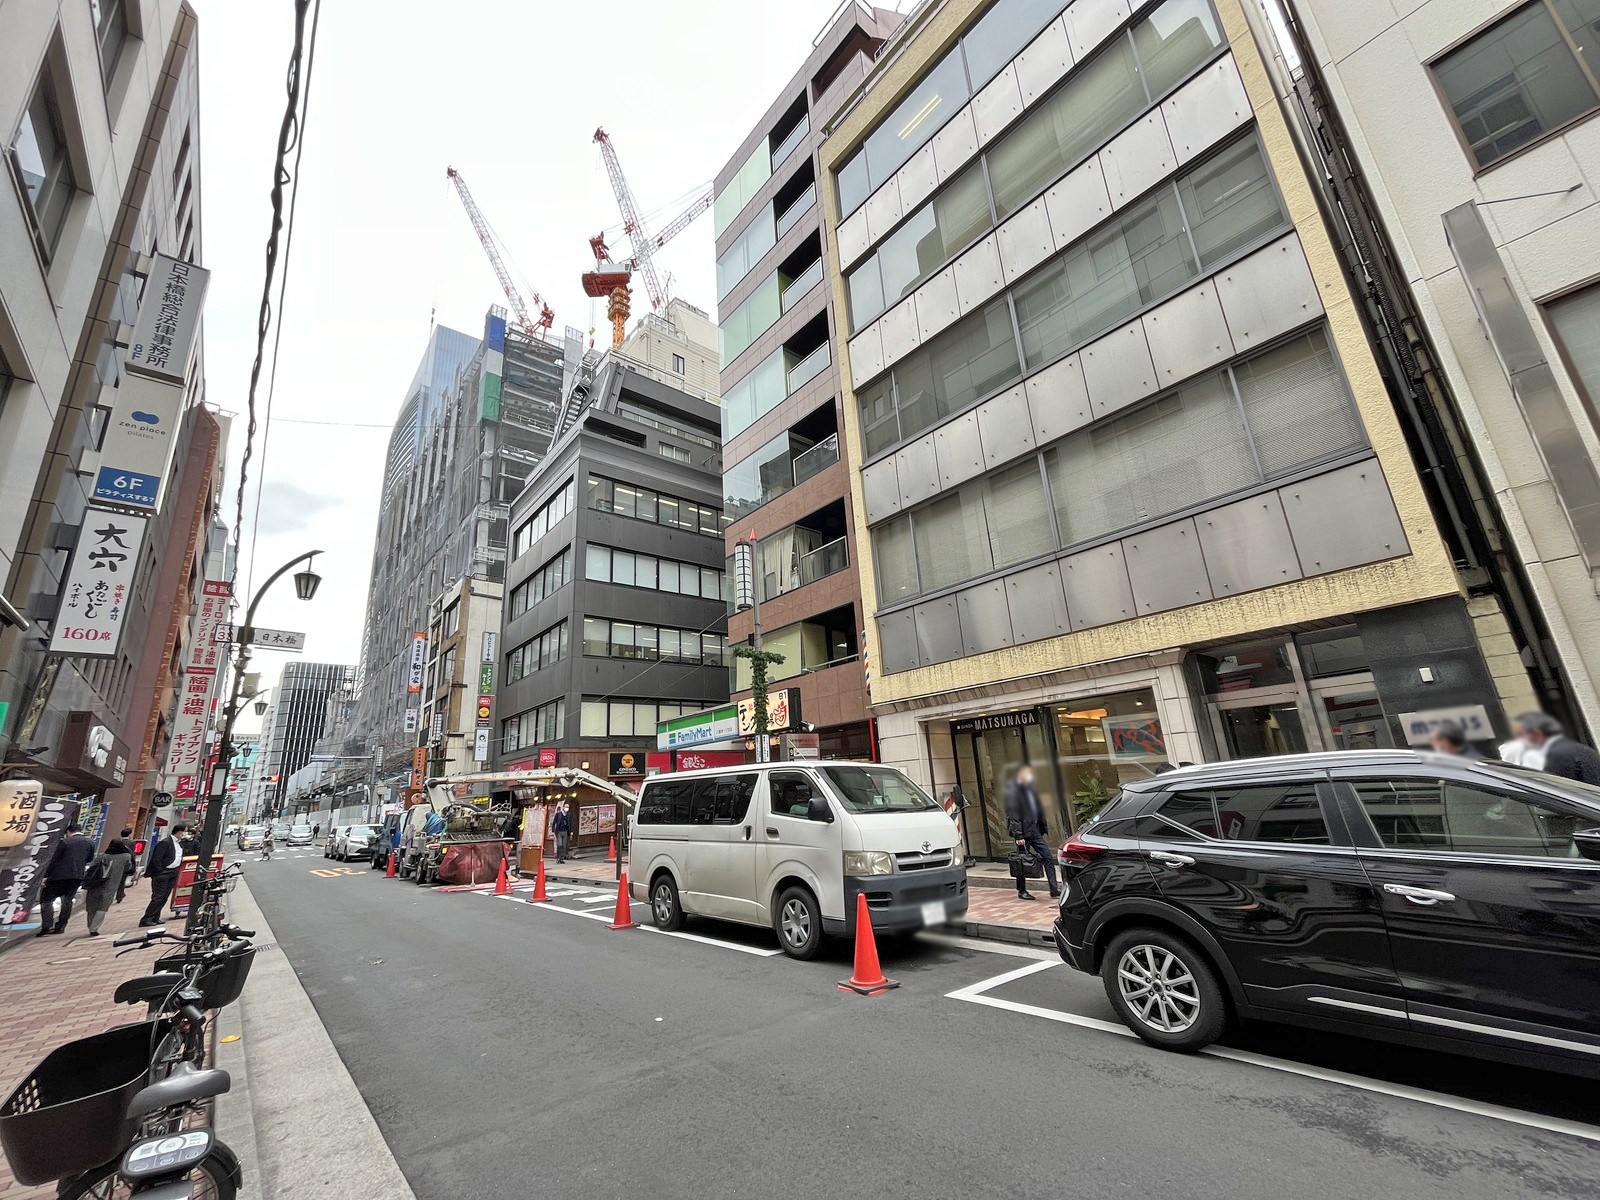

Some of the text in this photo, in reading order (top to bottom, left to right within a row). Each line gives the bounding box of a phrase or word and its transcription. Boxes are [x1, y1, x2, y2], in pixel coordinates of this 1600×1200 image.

[146, 262, 190, 369] 日本橋総合法律事務所
[131, 343, 144, 361] 8F
[118, 420, 166, 436] zen place
[127, 429, 154, 440] pilates
[113, 475, 144, 490] 6F
[88, 522, 132, 573] 大穴
[67, 582, 83, 608] ハイボール
[62, 626, 112, 642] 160席
[262, 633, 297, 646] 日本橋
[182, 675, 210, 716] 絵画・油絵
[974, 712, 1035, 731] MATSUNAGA
[677, 726, 713, 743] FamilyMart
[170, 733, 188, 773] ギャラリー
[154, 795, 171, 803] BAR
[2, 790, 38, 834] 酒場
